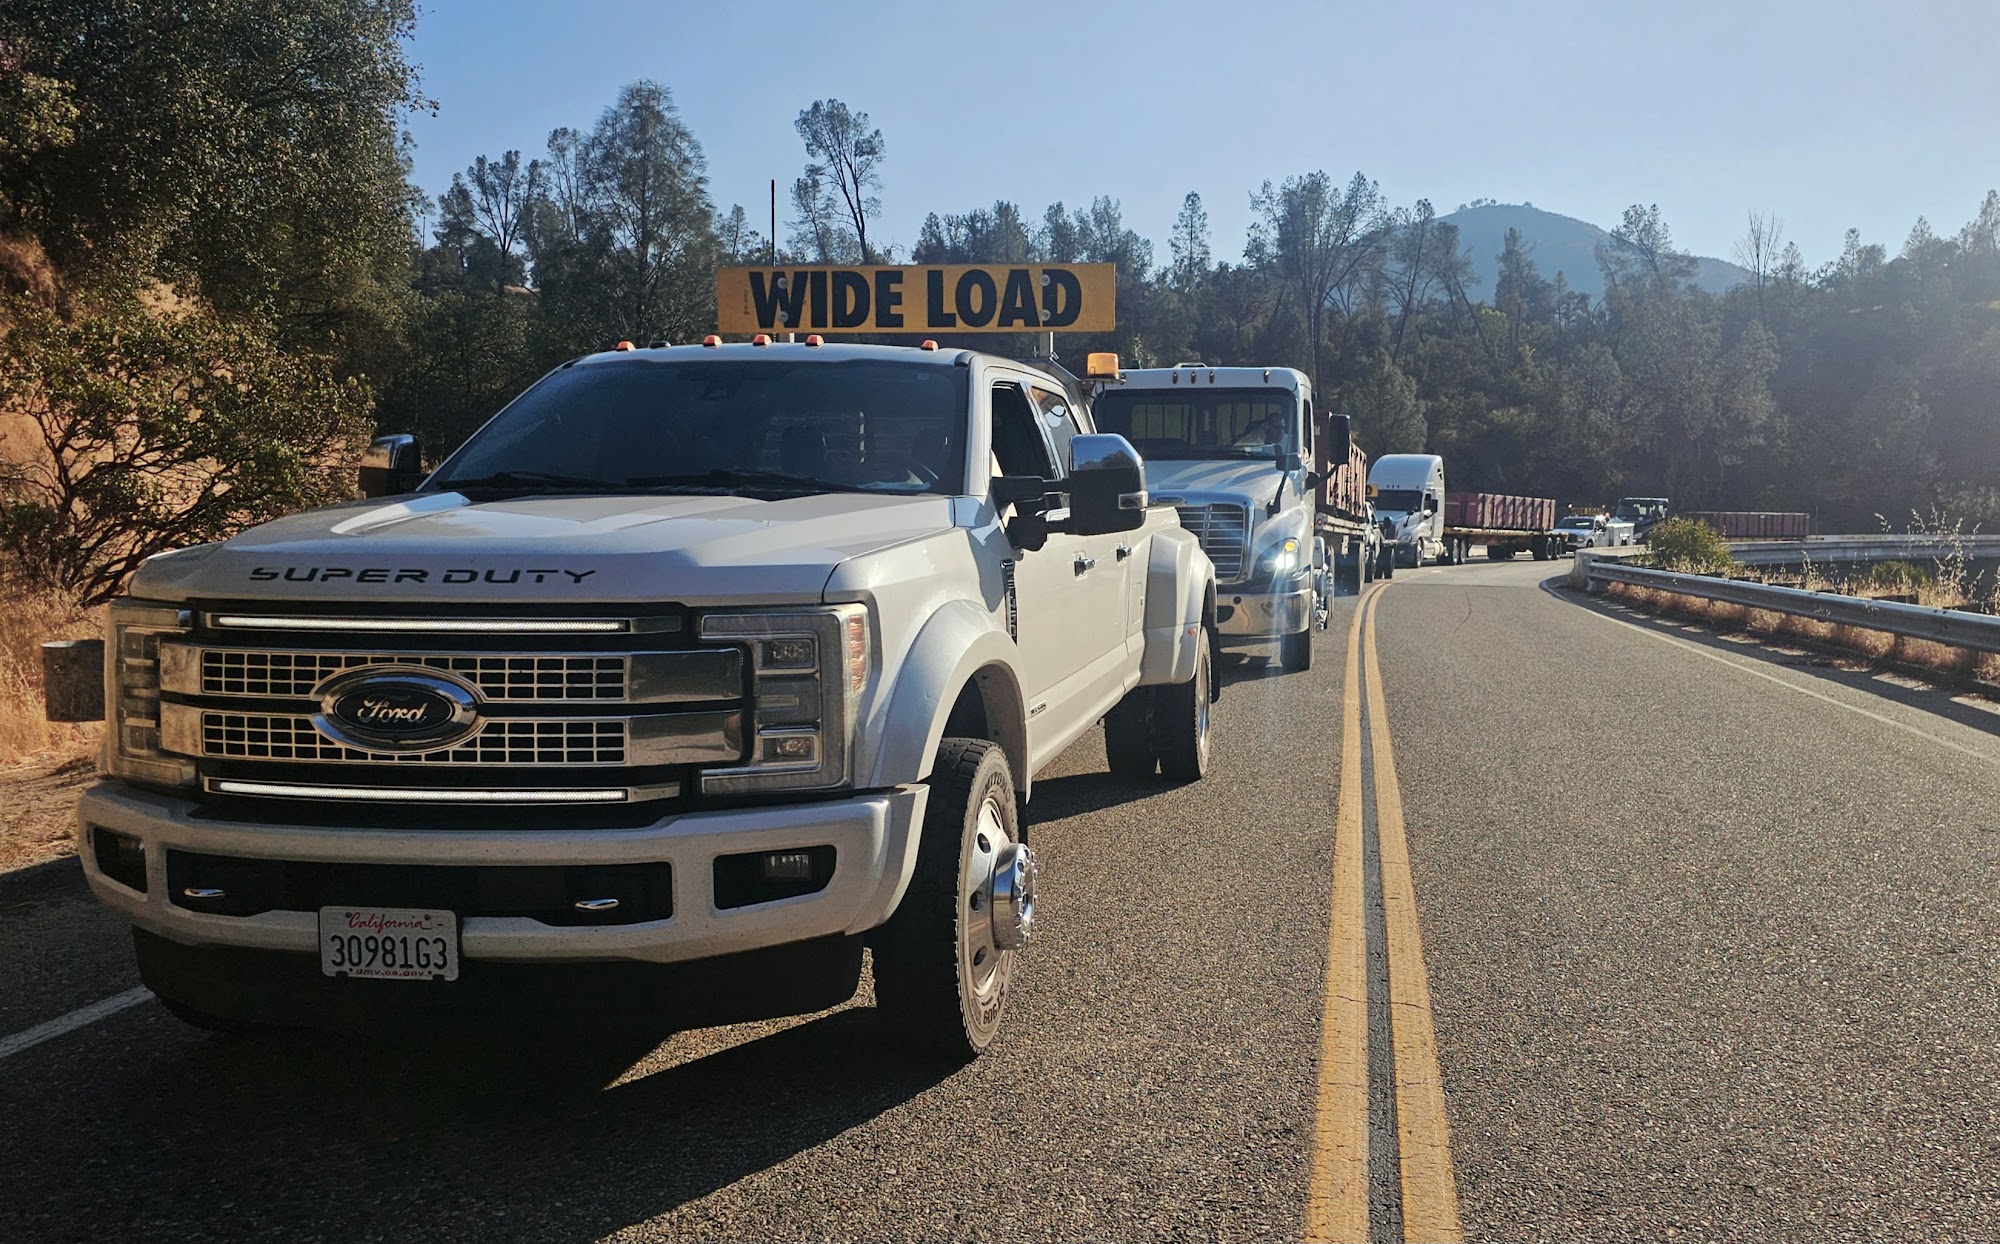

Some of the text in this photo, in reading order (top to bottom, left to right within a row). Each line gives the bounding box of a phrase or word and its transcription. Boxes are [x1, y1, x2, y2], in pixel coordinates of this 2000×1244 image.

[749, 270, 904, 328] WIDE
[927, 269, 1082, 327] LOAD
[249, 567, 596, 584] SUPER DUTY
[357, 698, 428, 723] Ford
[349, 912, 432, 933] California
[330, 934, 448, 970] 30981G3
[356, 968, 425, 977] dmv.ca.gov
